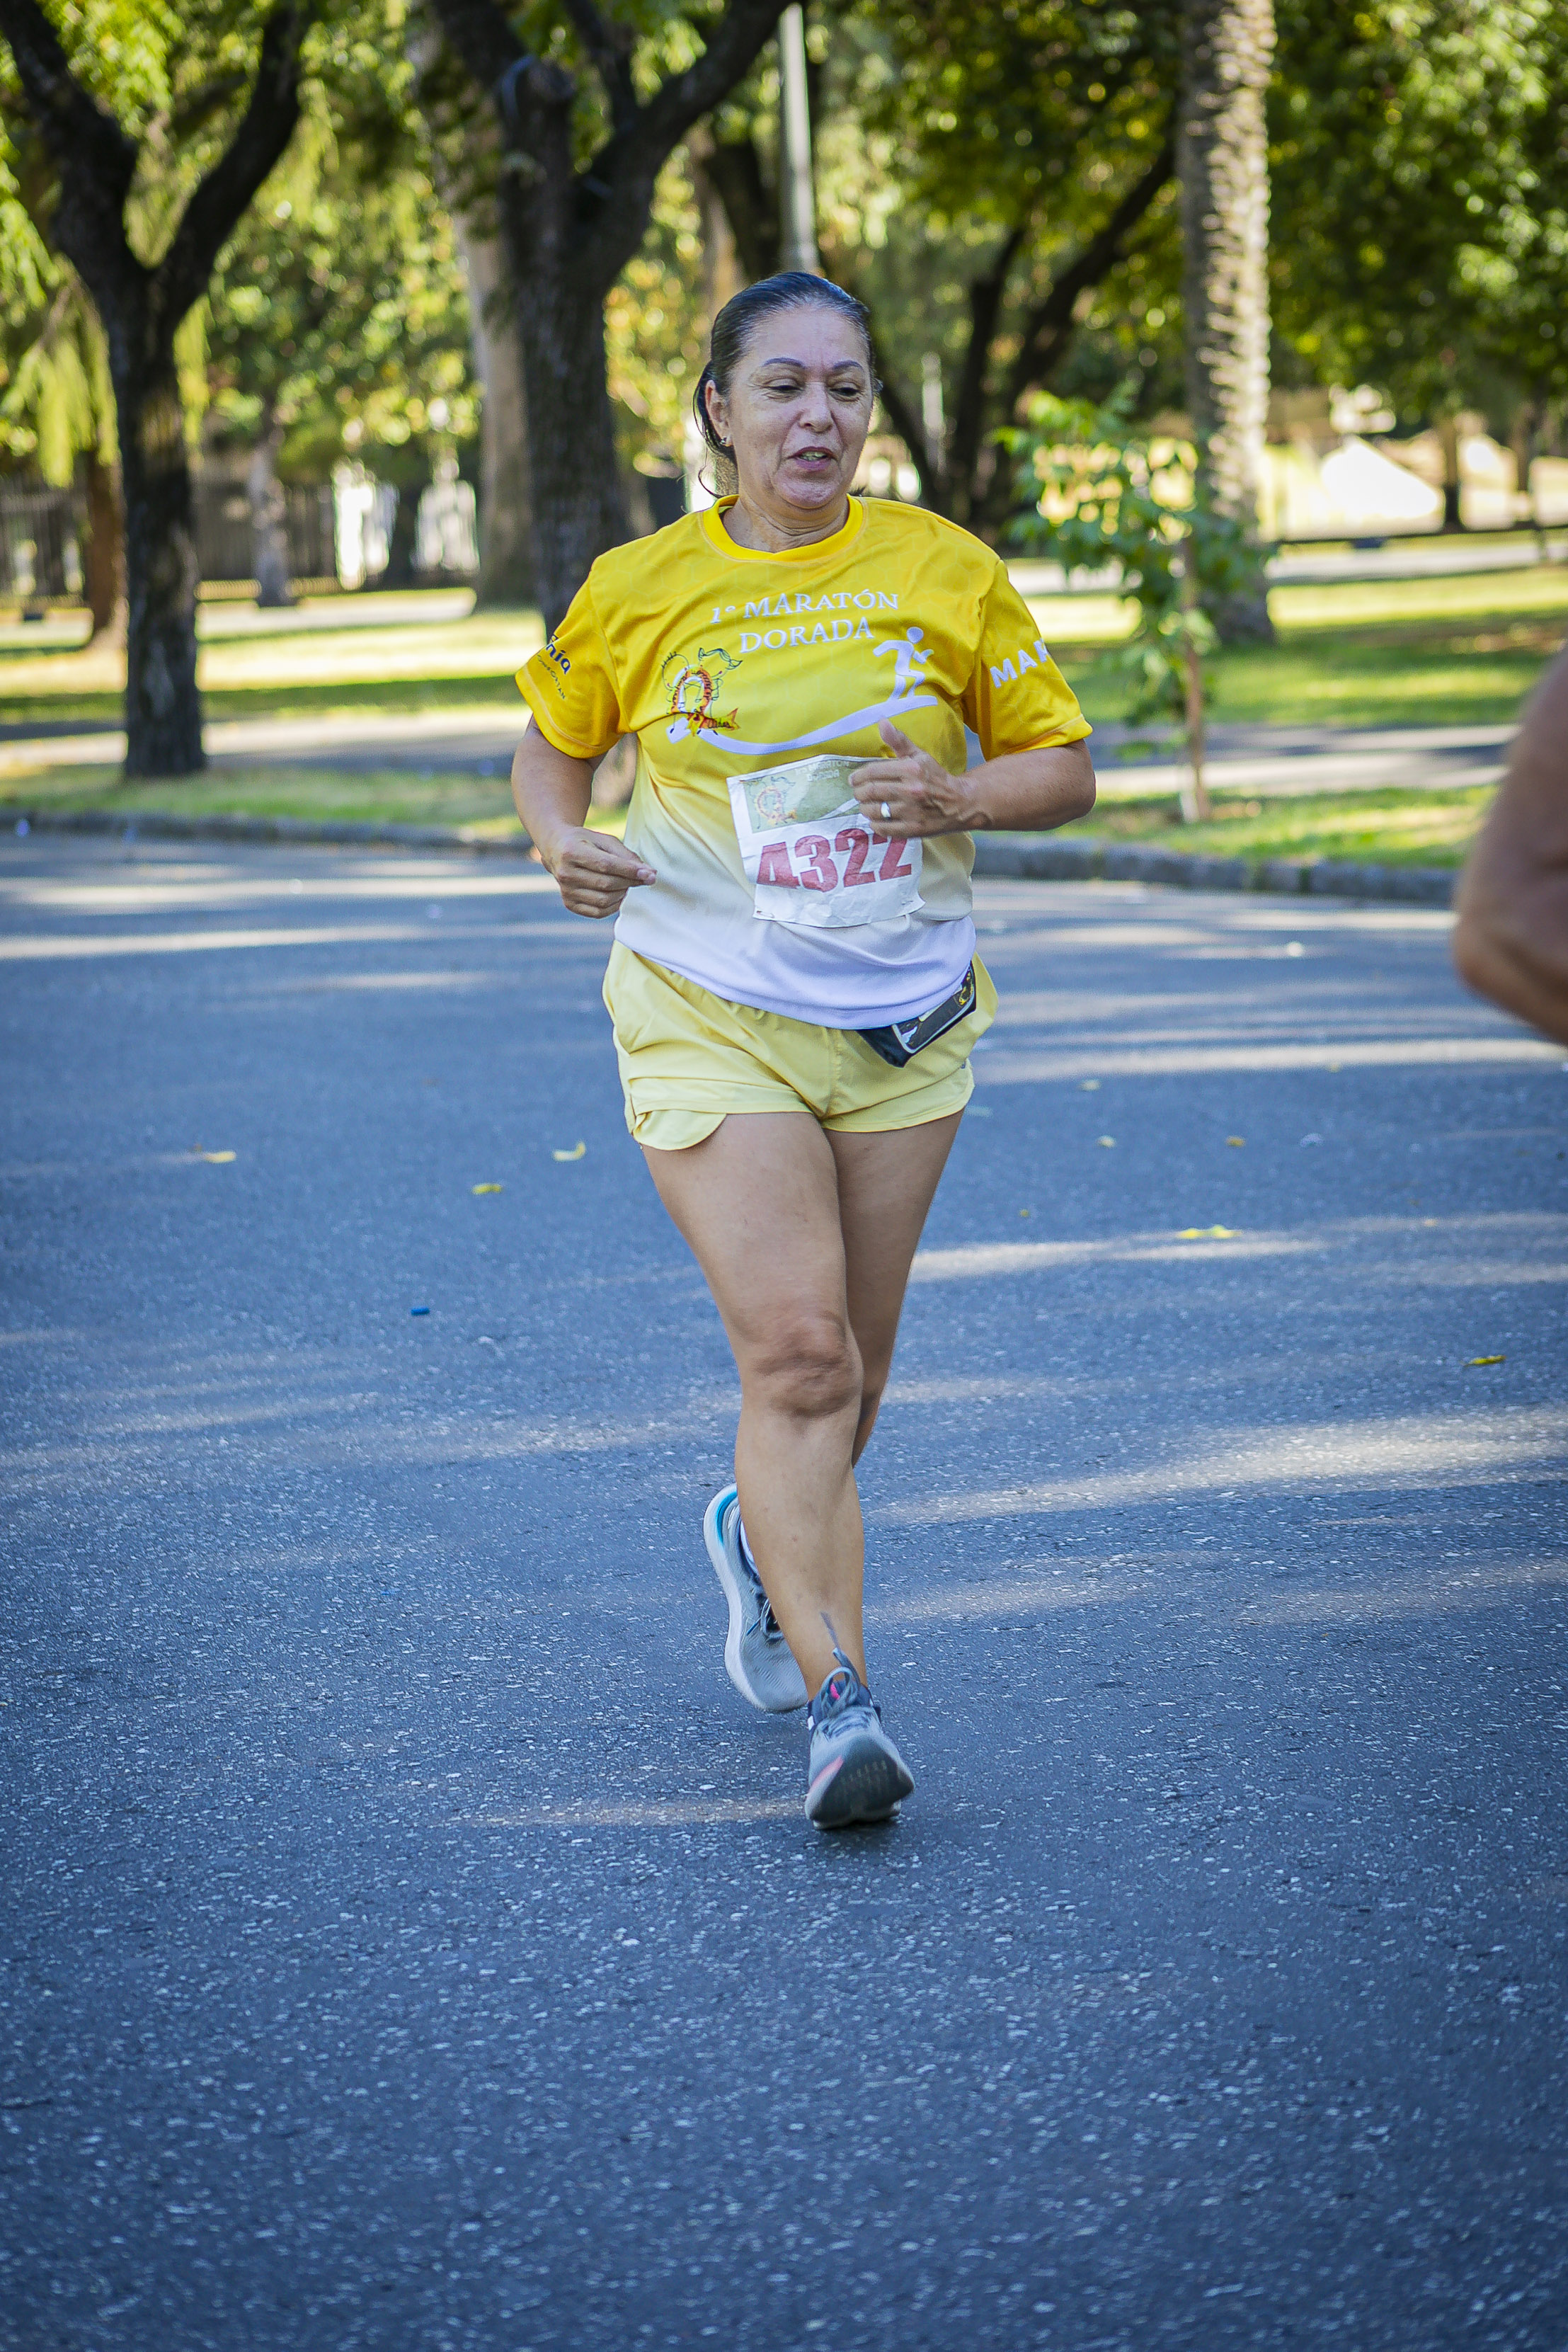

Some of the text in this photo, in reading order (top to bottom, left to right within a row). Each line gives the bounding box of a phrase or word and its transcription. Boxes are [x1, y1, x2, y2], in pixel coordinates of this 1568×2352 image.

[743, 588, 899, 619] MARATÓN
[740, 617, 875, 653] DORADA
[757, 828, 912, 893] 4322
